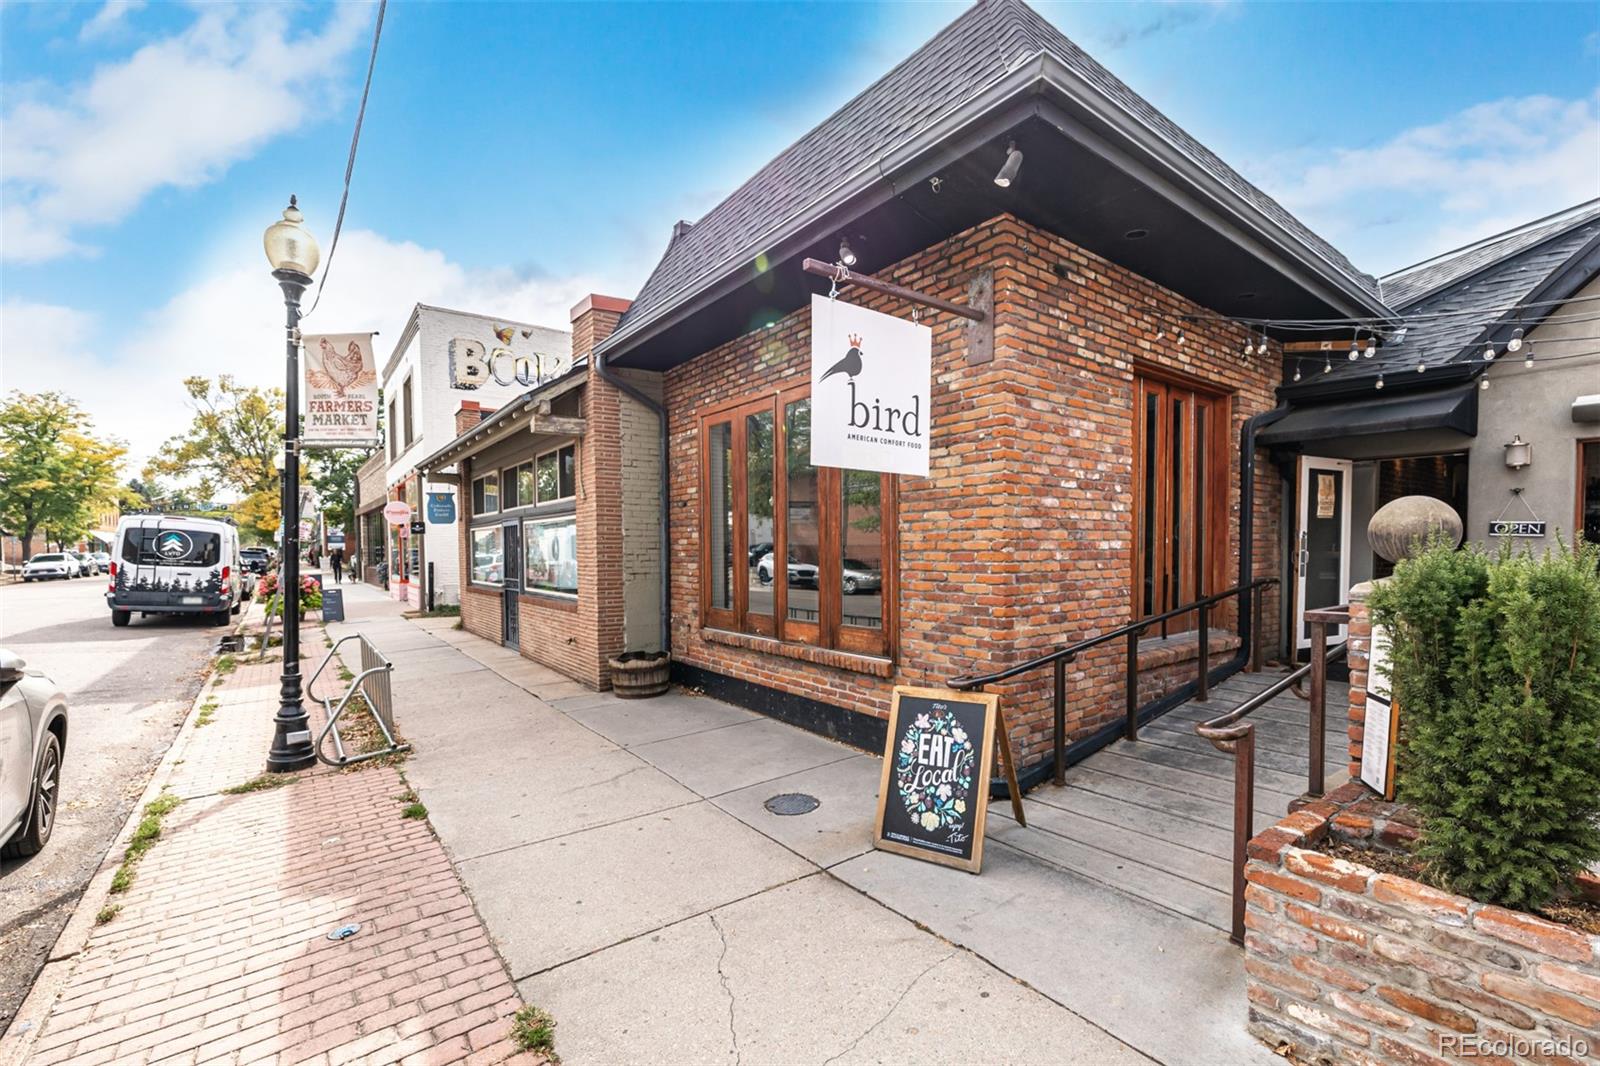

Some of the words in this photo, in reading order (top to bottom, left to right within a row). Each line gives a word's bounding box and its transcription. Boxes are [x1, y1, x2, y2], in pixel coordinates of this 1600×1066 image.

[309, 401, 374, 413] FARMERS
[847, 381, 922, 437] bird
[312, 414, 368, 426] MARKET
[847, 433, 878, 443] AMERICAN
[880, 437, 906, 446] COMFORT
[907, 441, 922, 450] FOOD
[1494, 523, 1541, 534] OPEN
[918, 733, 954, 768] EAT
